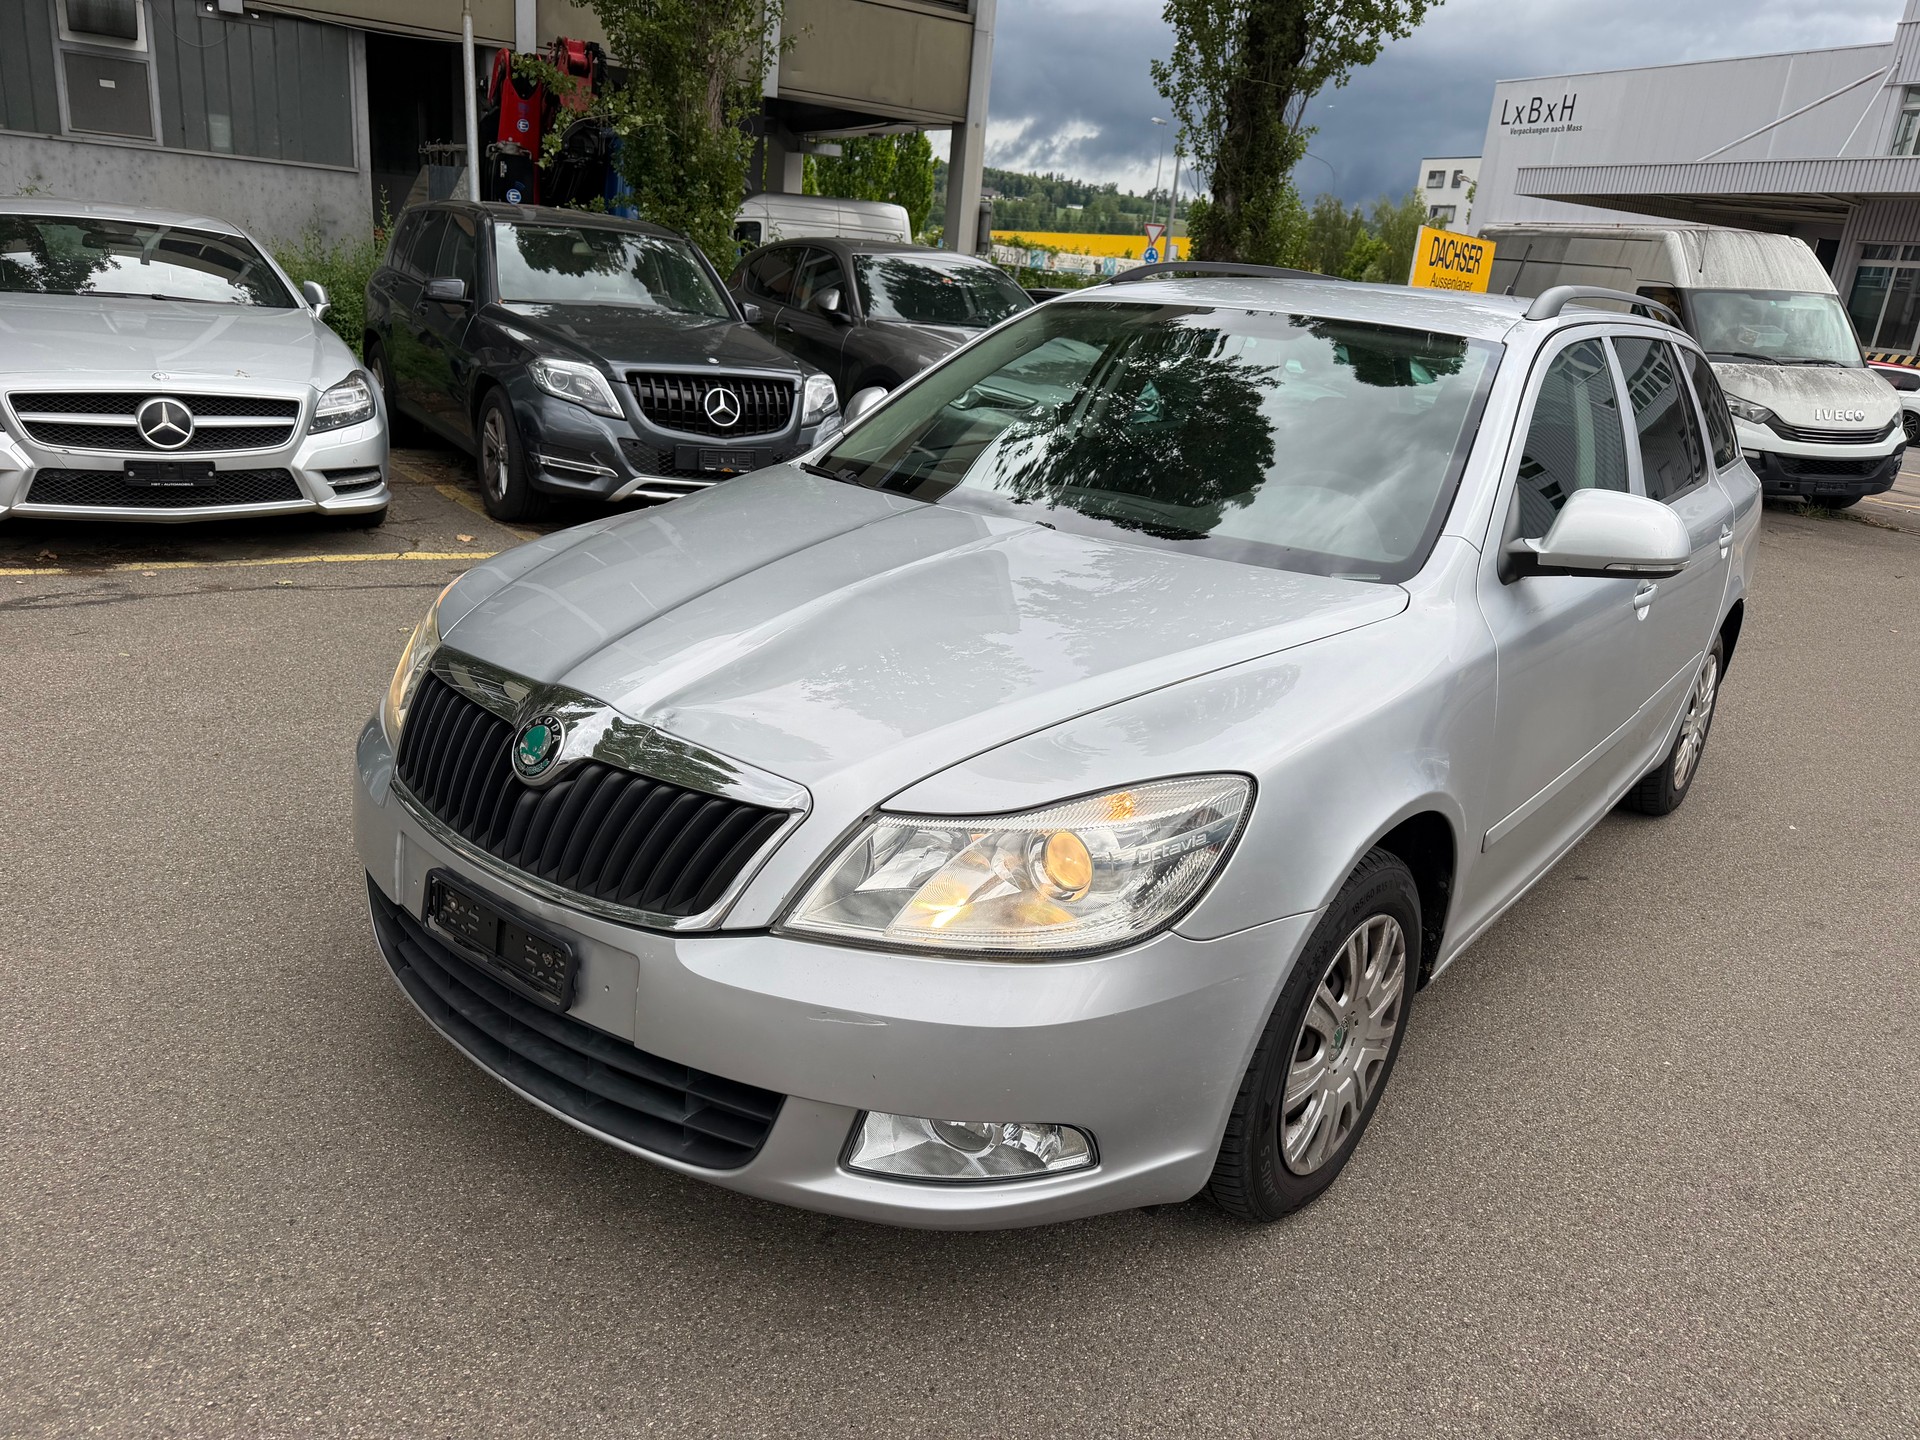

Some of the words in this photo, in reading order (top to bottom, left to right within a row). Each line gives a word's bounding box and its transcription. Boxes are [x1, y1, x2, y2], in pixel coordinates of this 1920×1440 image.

[1501, 93, 1577, 126] LxBxH
[1509, 126, 1550, 136] Verpackungen
[1550, 124, 1565, 133] nach
[1566, 123, 1583, 132] Mass
[1429, 236, 1483, 275] DACHSER
[1815, 408, 1865, 422] IVECO
[525, 716, 561, 744] SKODA
[1138, 832, 1208, 864] Octavia
